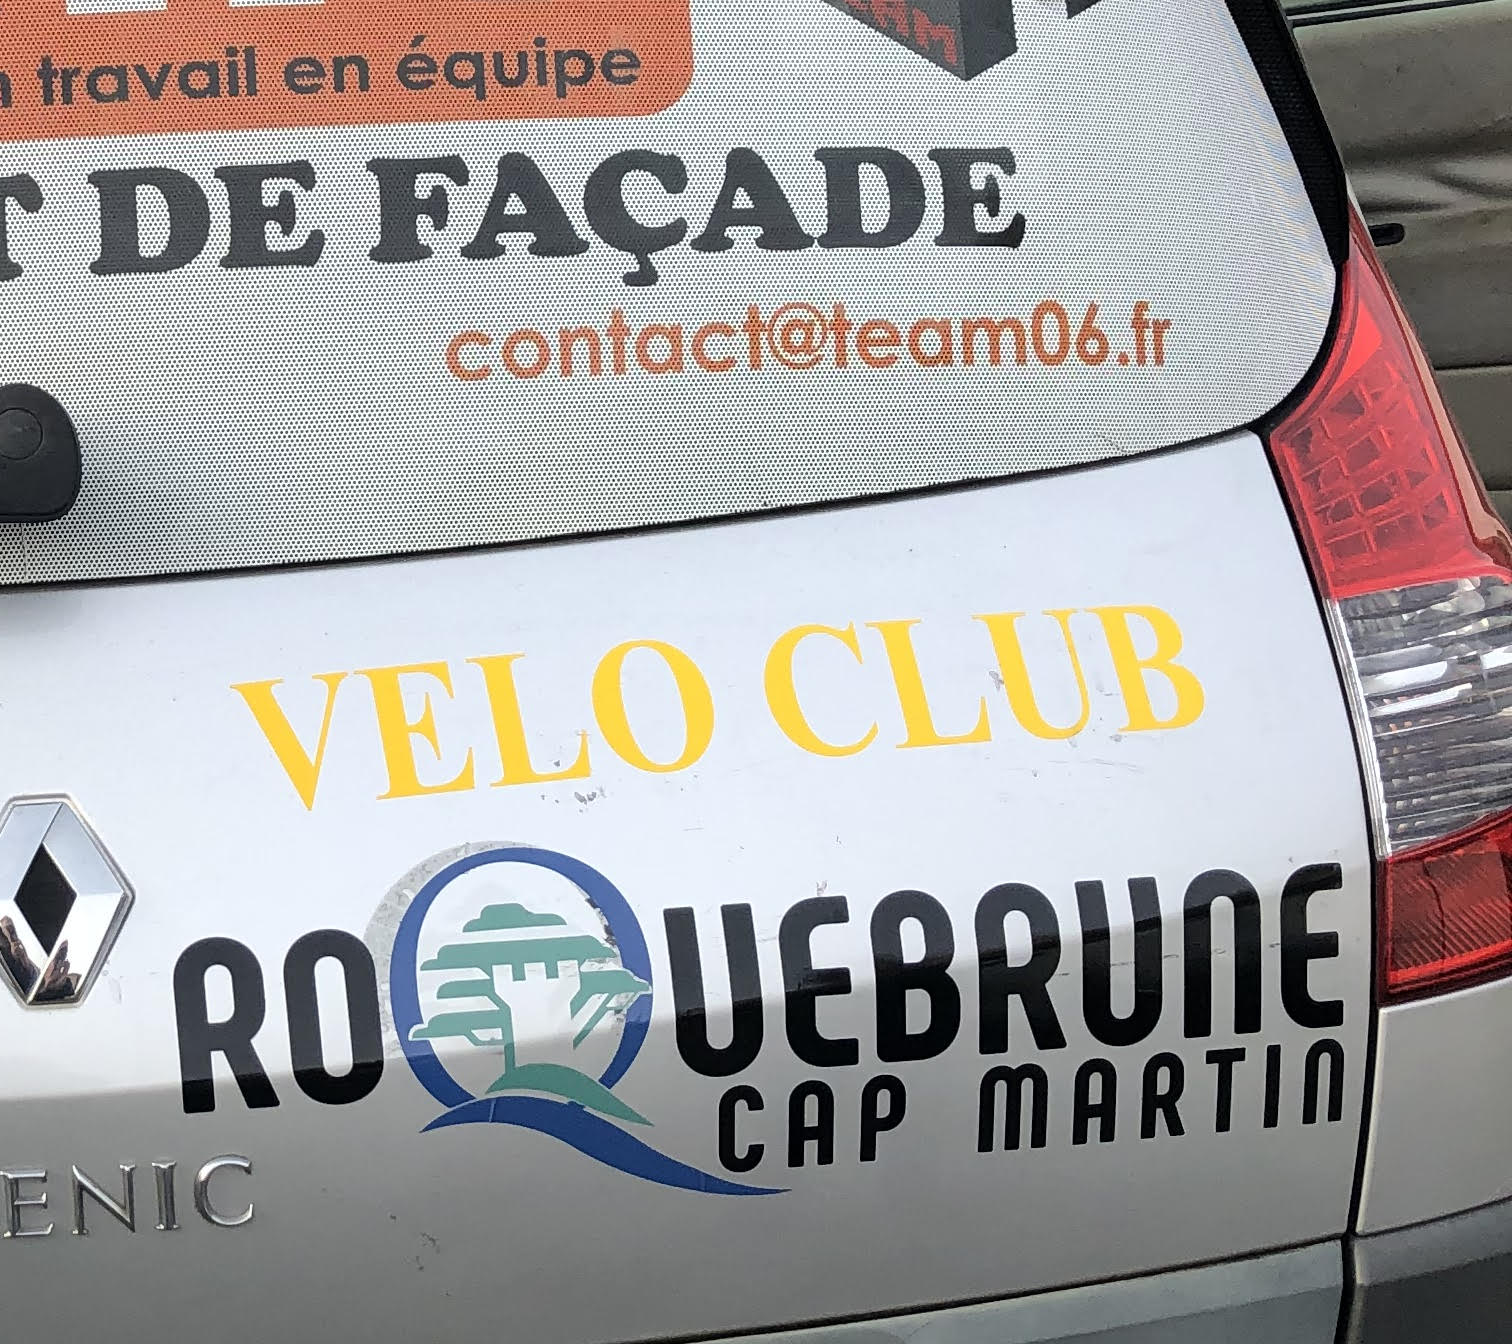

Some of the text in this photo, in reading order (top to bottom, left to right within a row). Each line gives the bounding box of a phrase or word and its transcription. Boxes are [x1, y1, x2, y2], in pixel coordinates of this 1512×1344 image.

[37, 47, 256, 106] travail
[283, 50, 370, 95] en
[396, 34, 641, 103] équipe
[87, 158, 326, 276] DE
[366, 146, 1026, 287] FAÇADE
[445, 299, 1172, 382] contact@team06.fr
[229, 604, 1206, 812] VELO CLUB
[717, 1038, 1345, 1173] CAP MARTIN
